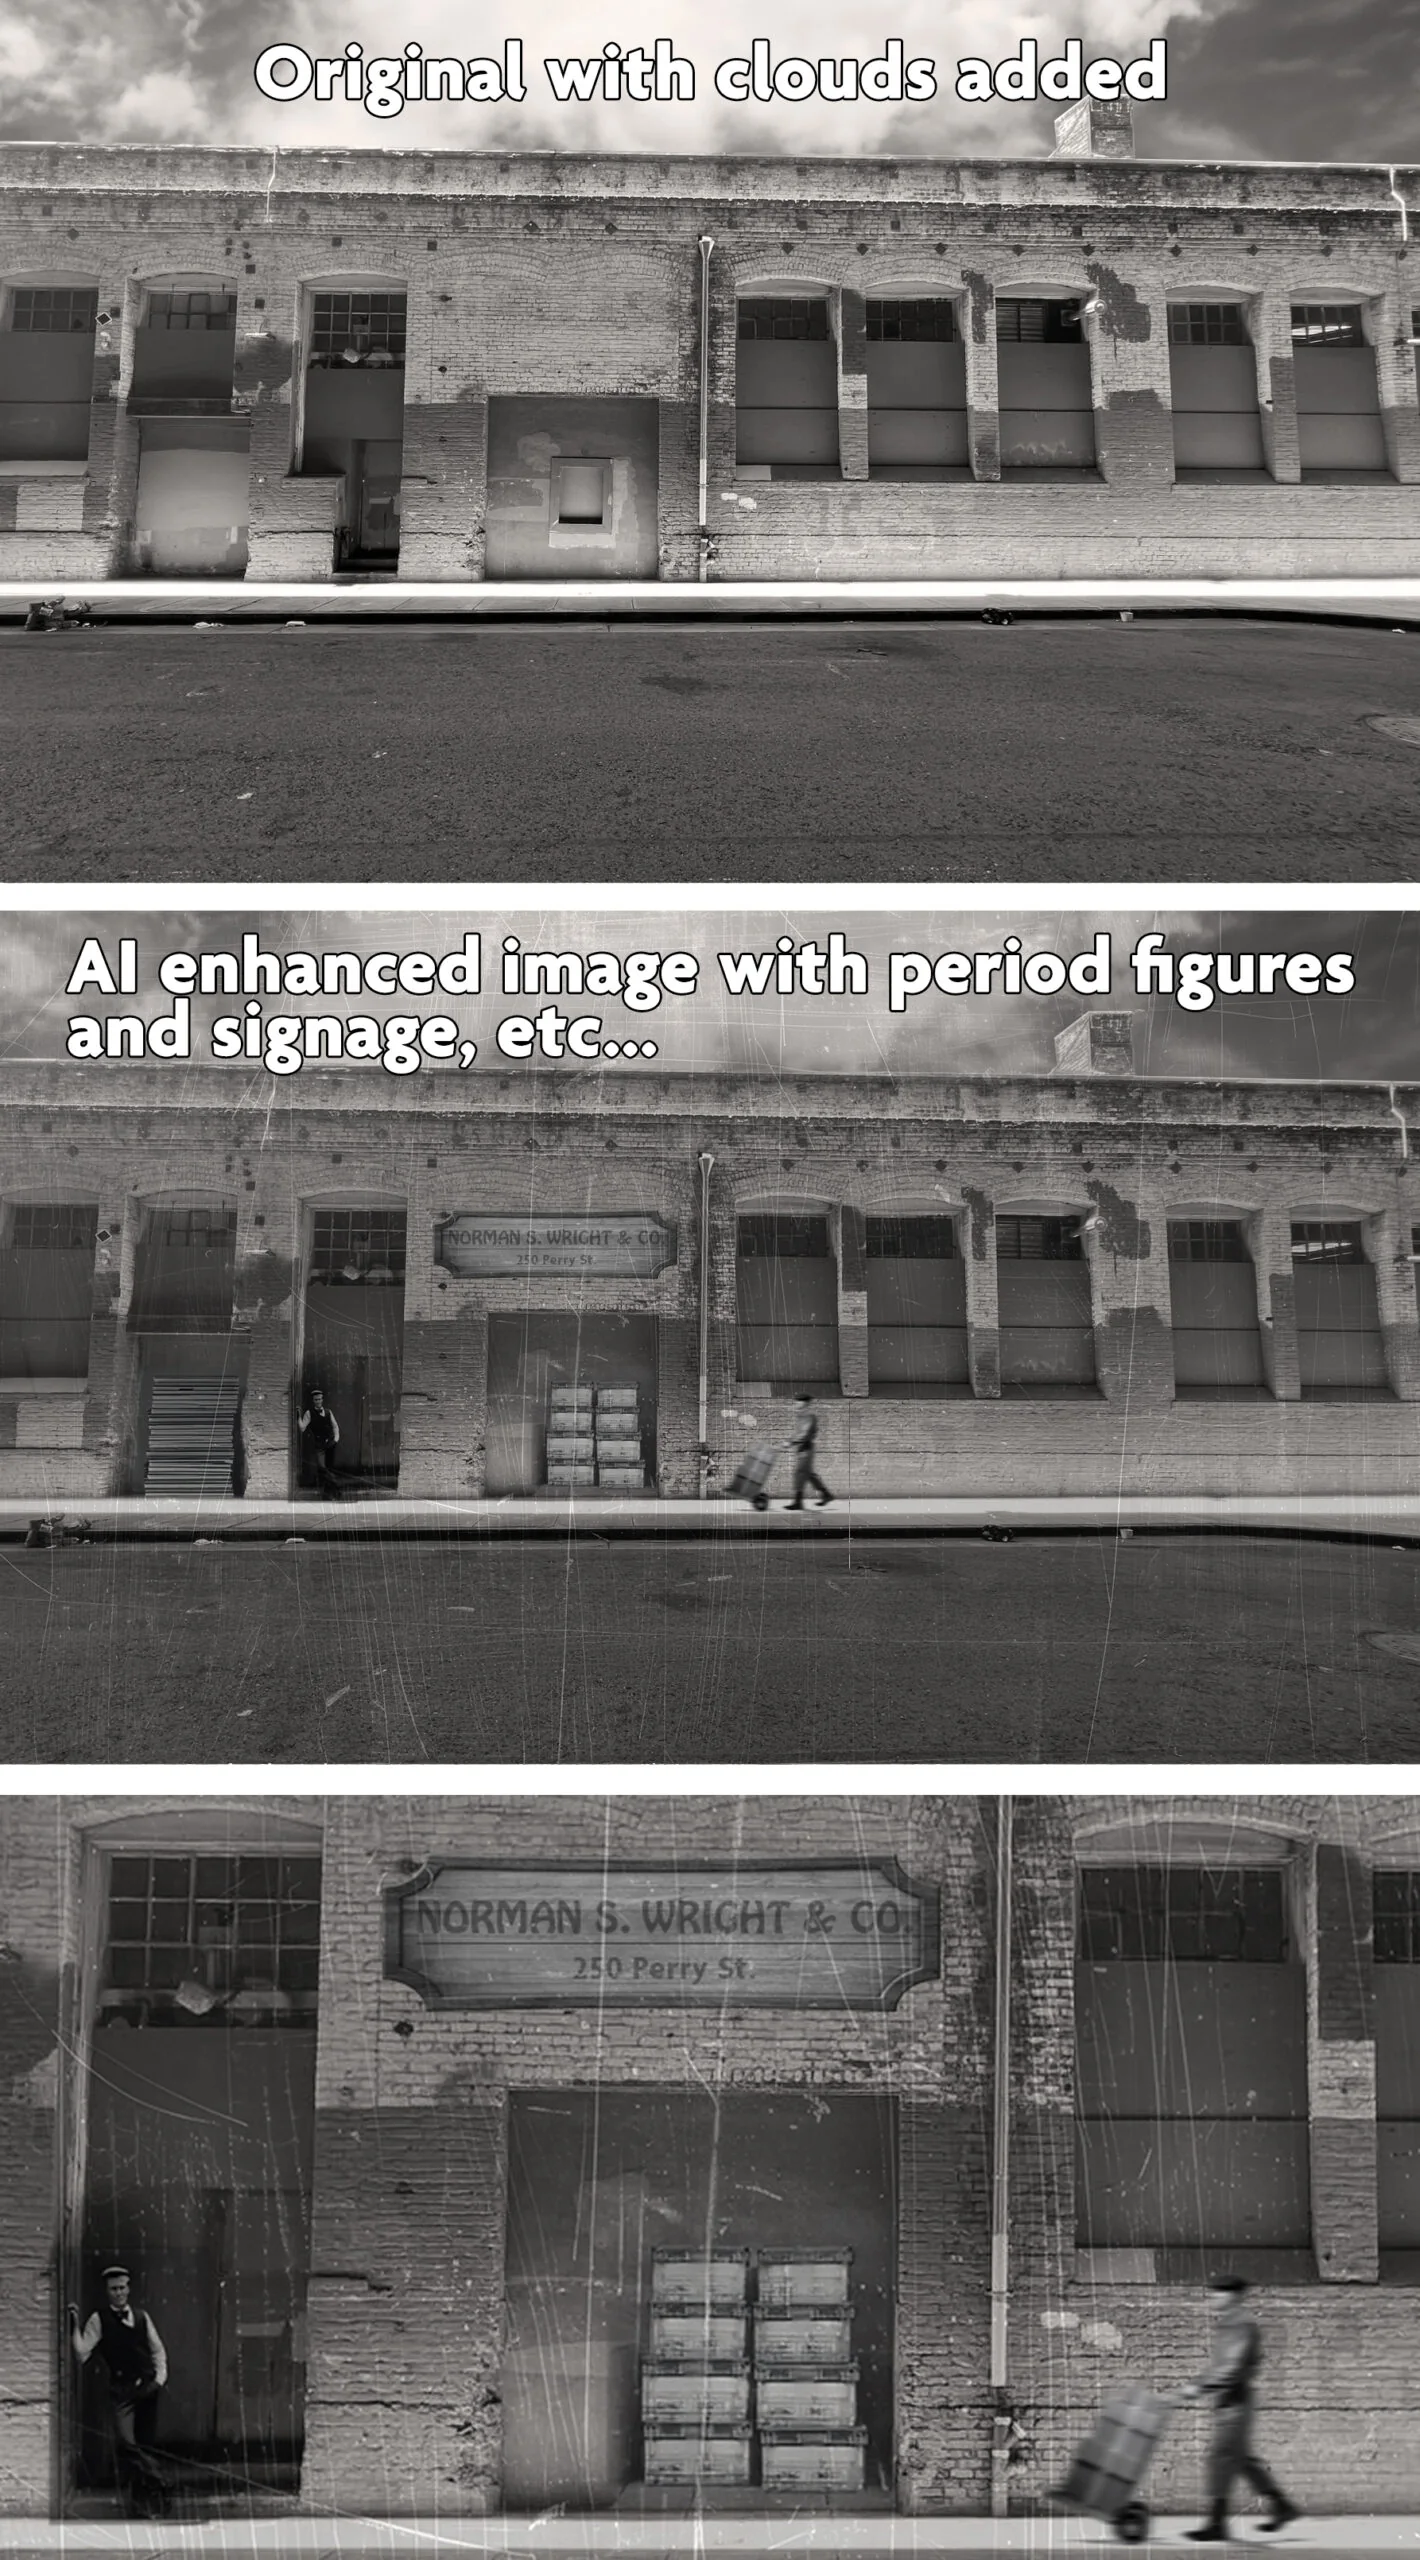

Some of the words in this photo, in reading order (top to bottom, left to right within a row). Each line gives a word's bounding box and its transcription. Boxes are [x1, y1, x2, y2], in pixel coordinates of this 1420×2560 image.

[449, 1230, 520, 1246] NORMAN
[526, 1230, 542, 1246] S.
[547, 1230, 611, 1246] WRIGHT
[617, 1230, 632, 1245] &
[516, 1254, 538, 1266] 250
[543, 1254, 575, 1268] Perry
[418, 1899, 582, 1935] NORMAN
[595, 1899, 630, 1935] S.
[641, 1899, 790, 1935] WRIGHT
[803, 1899, 837, 1934] &
[850, 1899, 913, 1934] CO.
[573, 1957, 623, 1981] 250
[633, 1956, 708, 1985] Perry
[718, 1956, 757, 1981] St.
